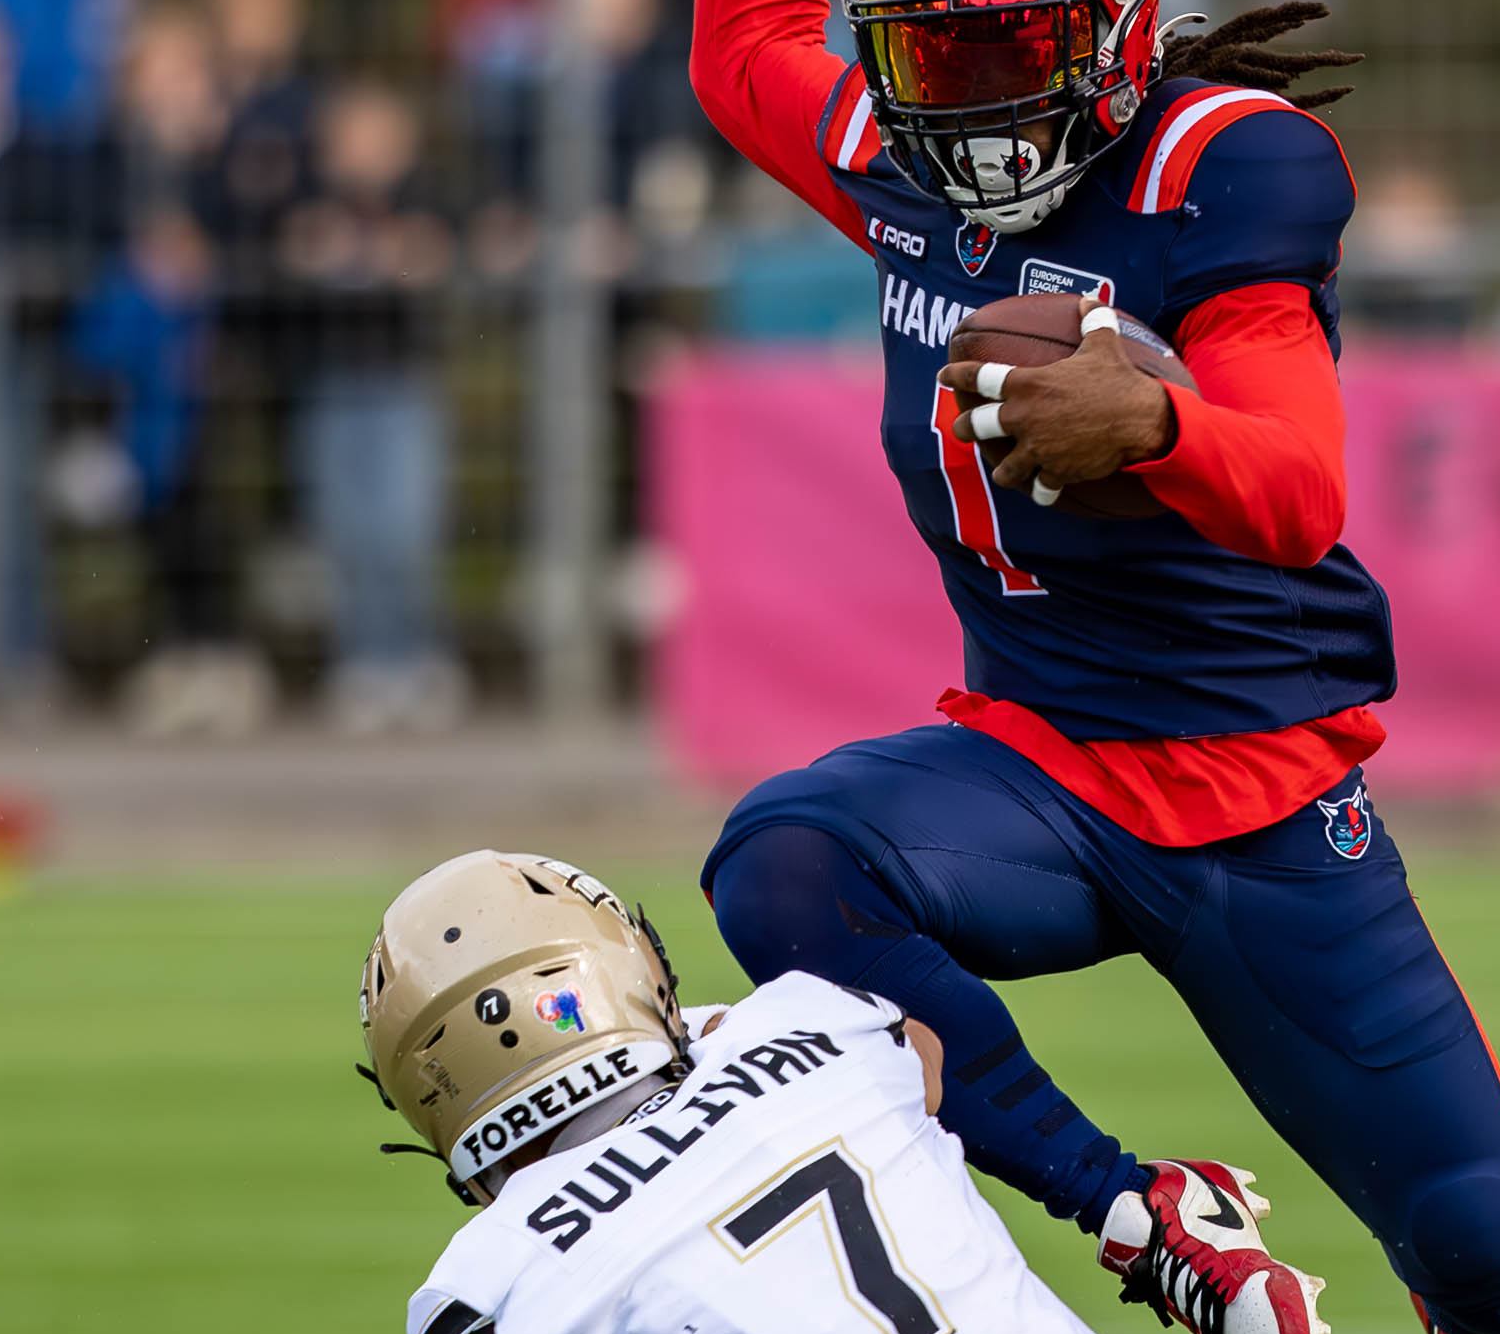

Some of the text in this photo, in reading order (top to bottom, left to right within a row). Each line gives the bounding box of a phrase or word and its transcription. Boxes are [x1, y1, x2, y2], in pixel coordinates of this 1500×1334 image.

[1030, 268, 1074, 288] EUROPEAN
[931, 383, 1049, 598] 1
[462, 1047, 640, 1169] FORELLE
[527, 1029, 845, 1254] SULLIVAN
